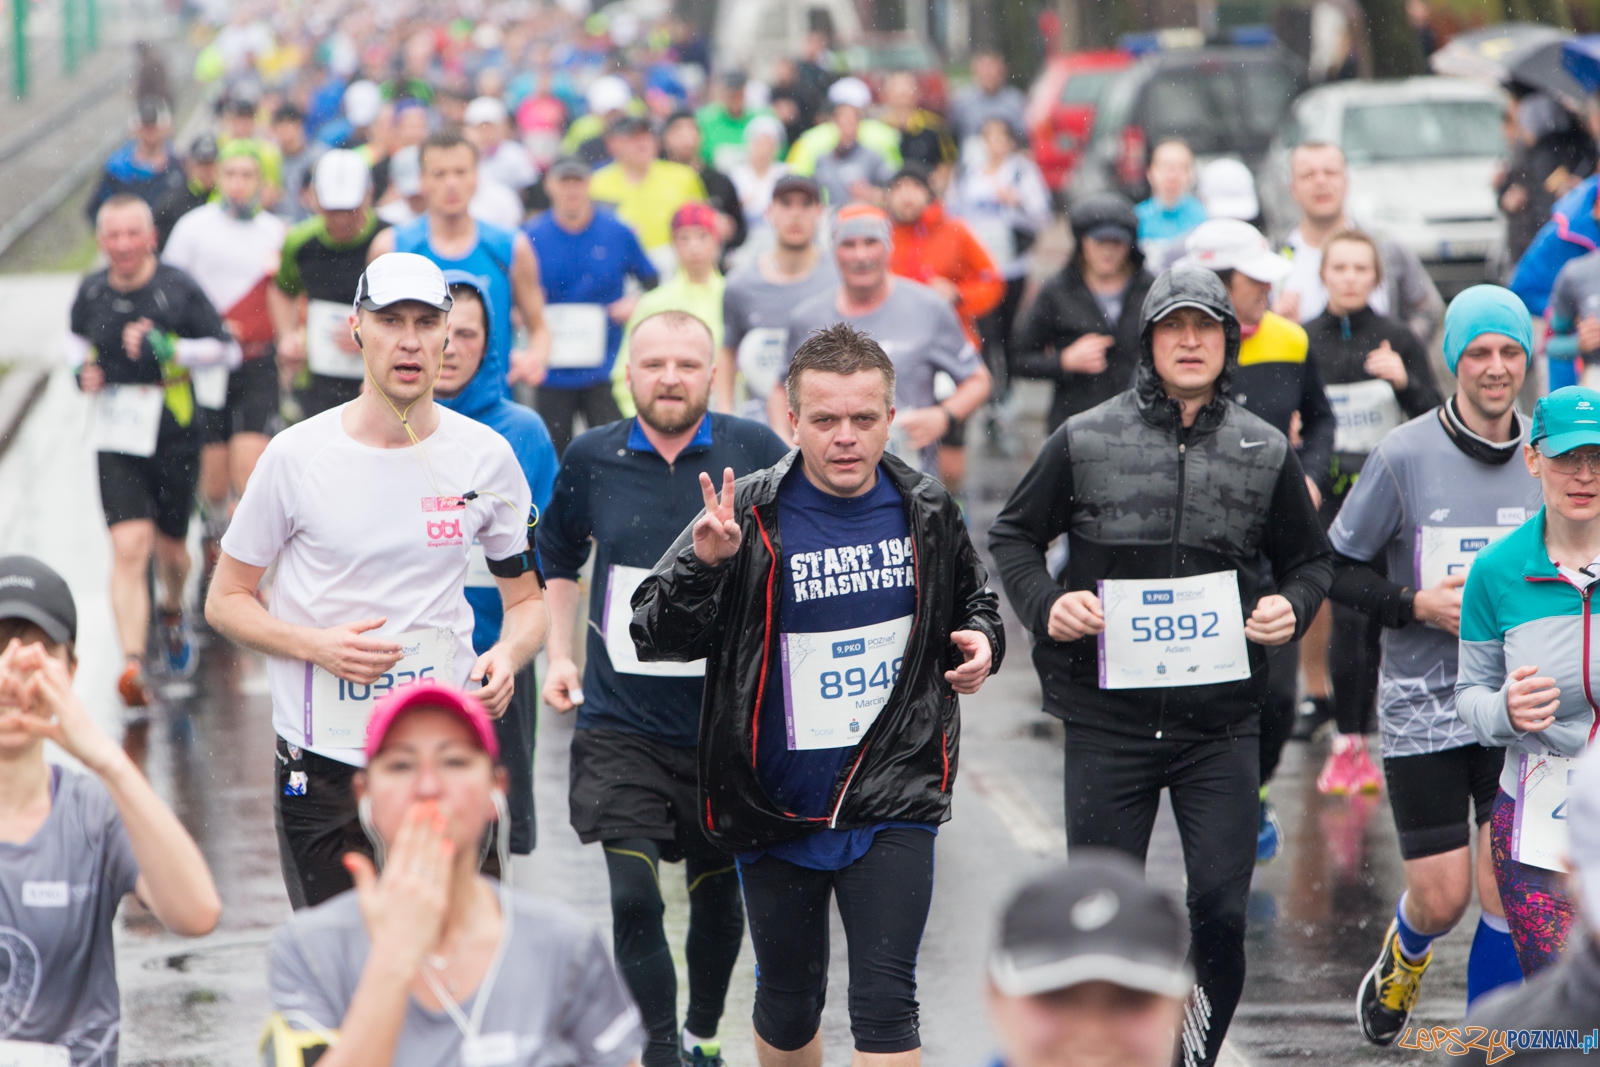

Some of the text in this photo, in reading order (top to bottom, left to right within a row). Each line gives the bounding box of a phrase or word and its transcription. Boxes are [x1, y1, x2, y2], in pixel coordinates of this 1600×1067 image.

[1429, 508, 1450, 522] 4F
[790, 544, 874, 581] START
[793, 565, 915, 602] KRASNYSTA
[1146, 593, 1170, 602] 9.PKO
[1132, 611, 1219, 642] 5892
[836, 643, 861, 654] 9.PKO
[855, 696, 885, 709] Marcin
